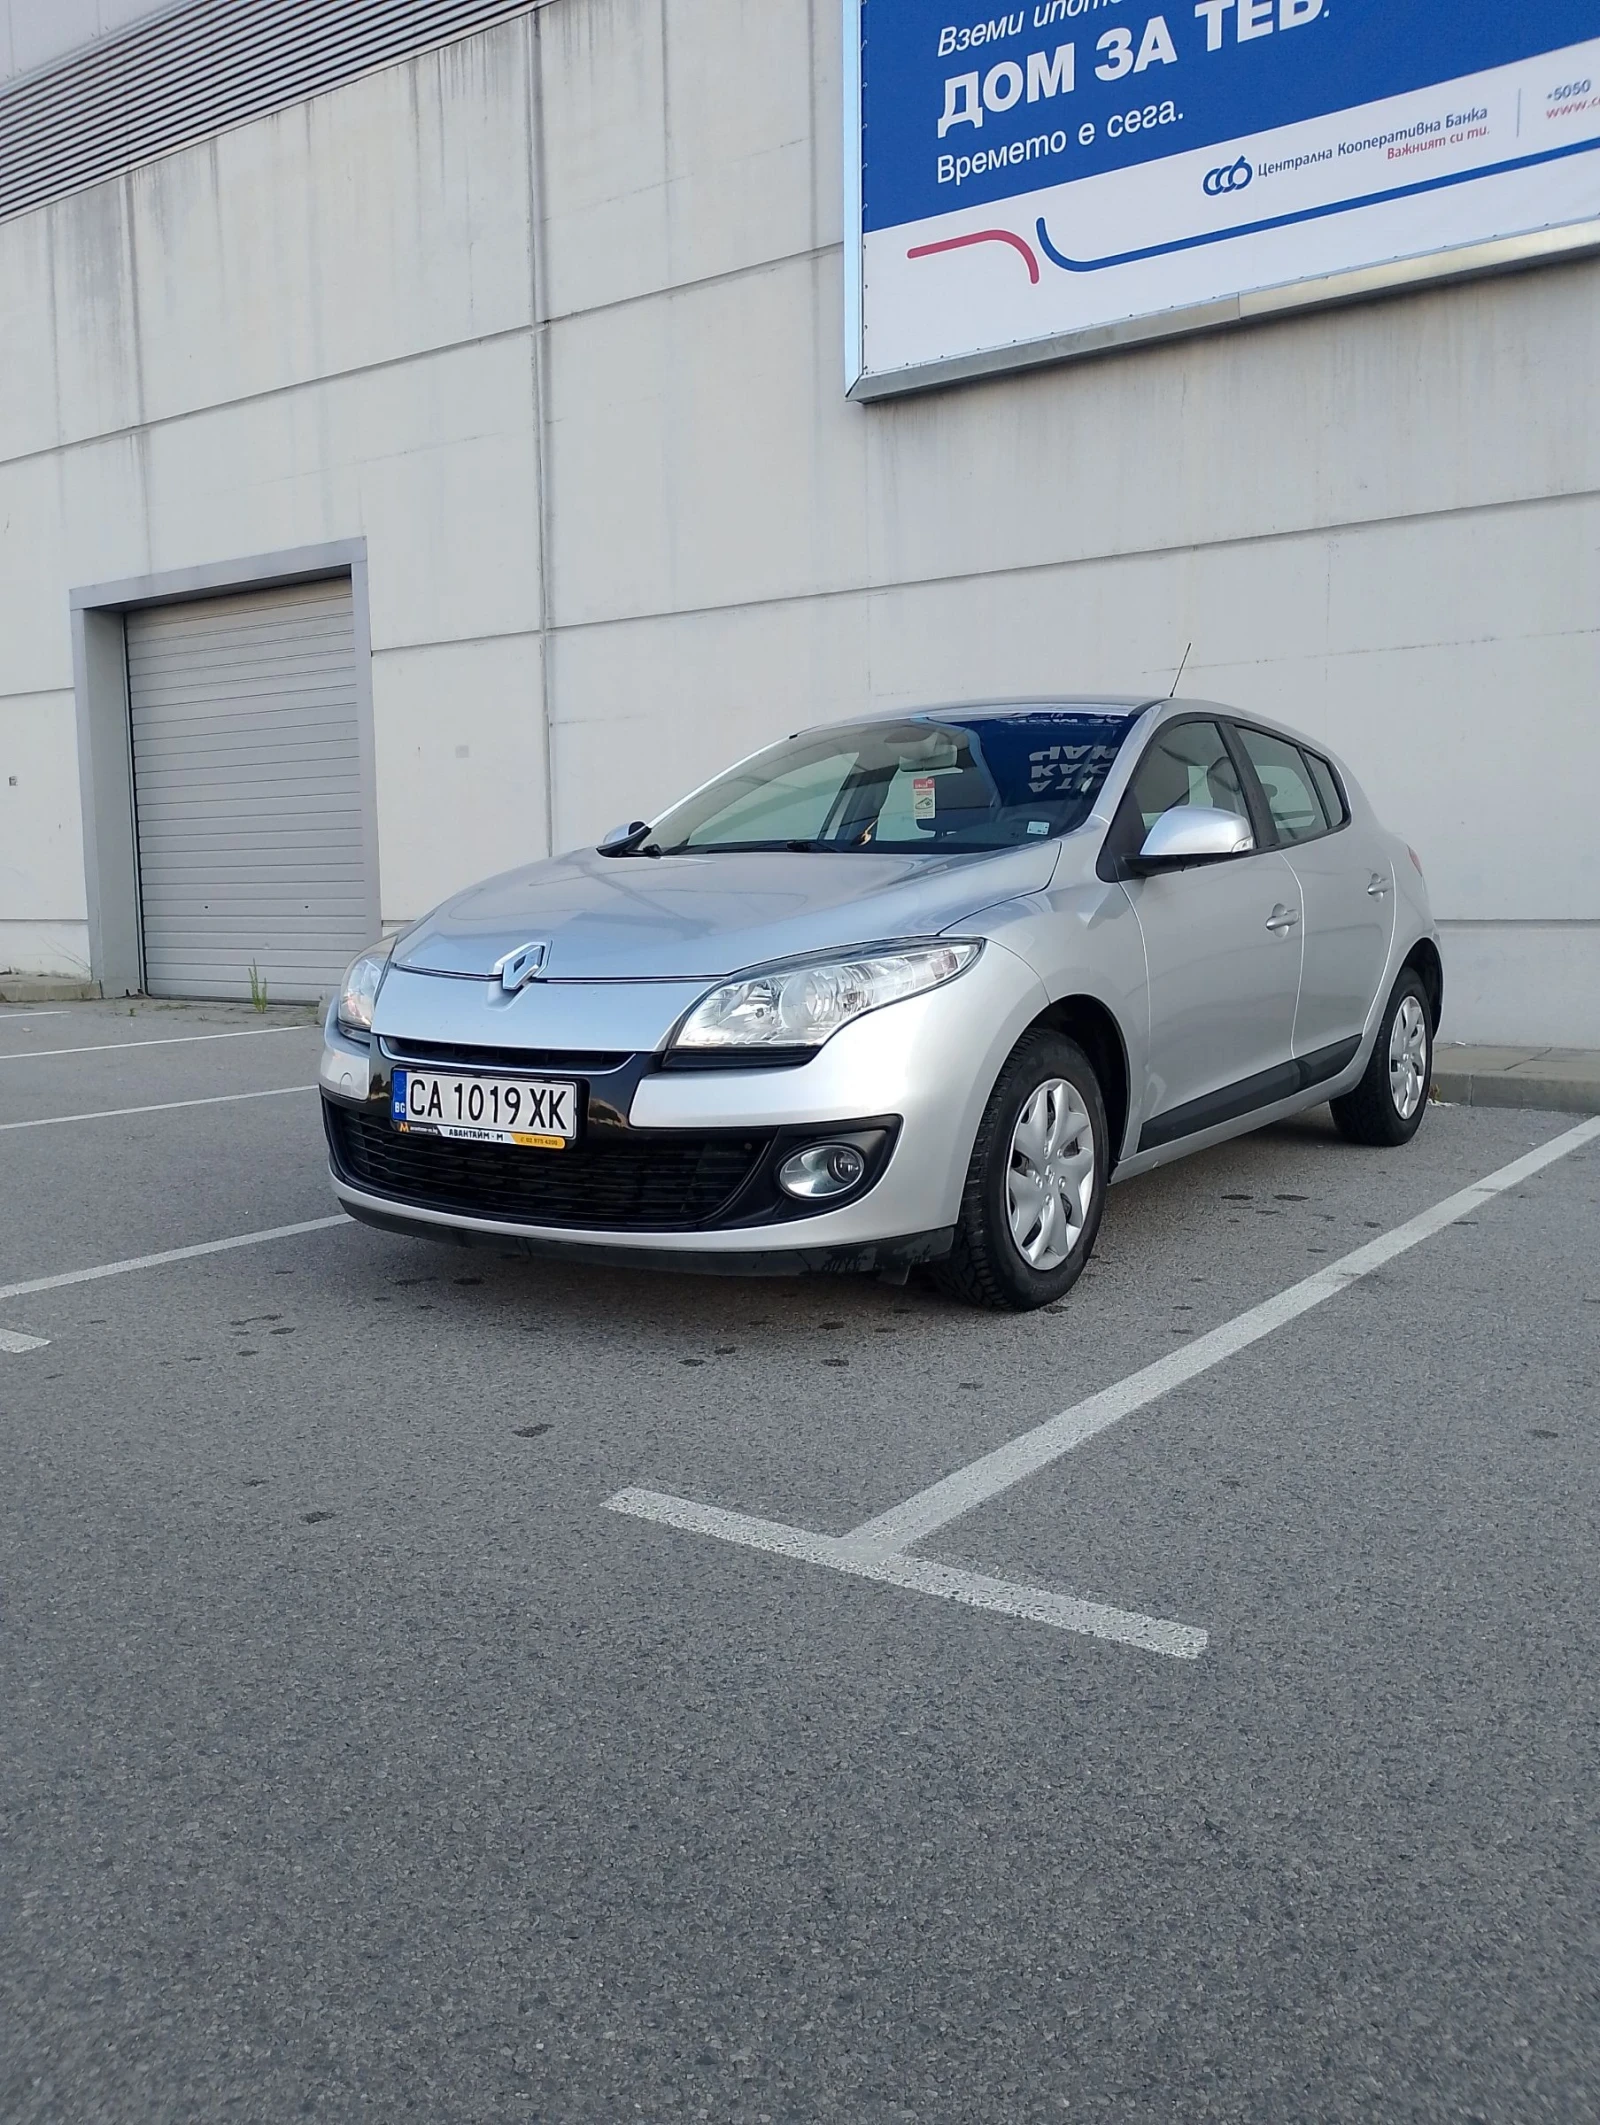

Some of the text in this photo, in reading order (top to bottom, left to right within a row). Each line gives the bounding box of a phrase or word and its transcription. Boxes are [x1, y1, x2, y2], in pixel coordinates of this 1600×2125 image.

[938, 0, 1122, 57] Вземи ипо
[937, 43, 1075, 138] ДОМ
[1094, 15, 1178, 82] ЗА
[1546, 96, 1600, 119] www.c
[937, 100, 1184, 185] Времето е сега.
[1258, 107, 1488, 178] Централна Кооперативна Банка
[1387, 125, 1490, 160] Важният си ти.
[394, 1101, 406, 1114] BG
[410, 1079, 567, 1130] CA 1019 XK
[448, 1128, 490, 1141] АВАНТАЙМ
